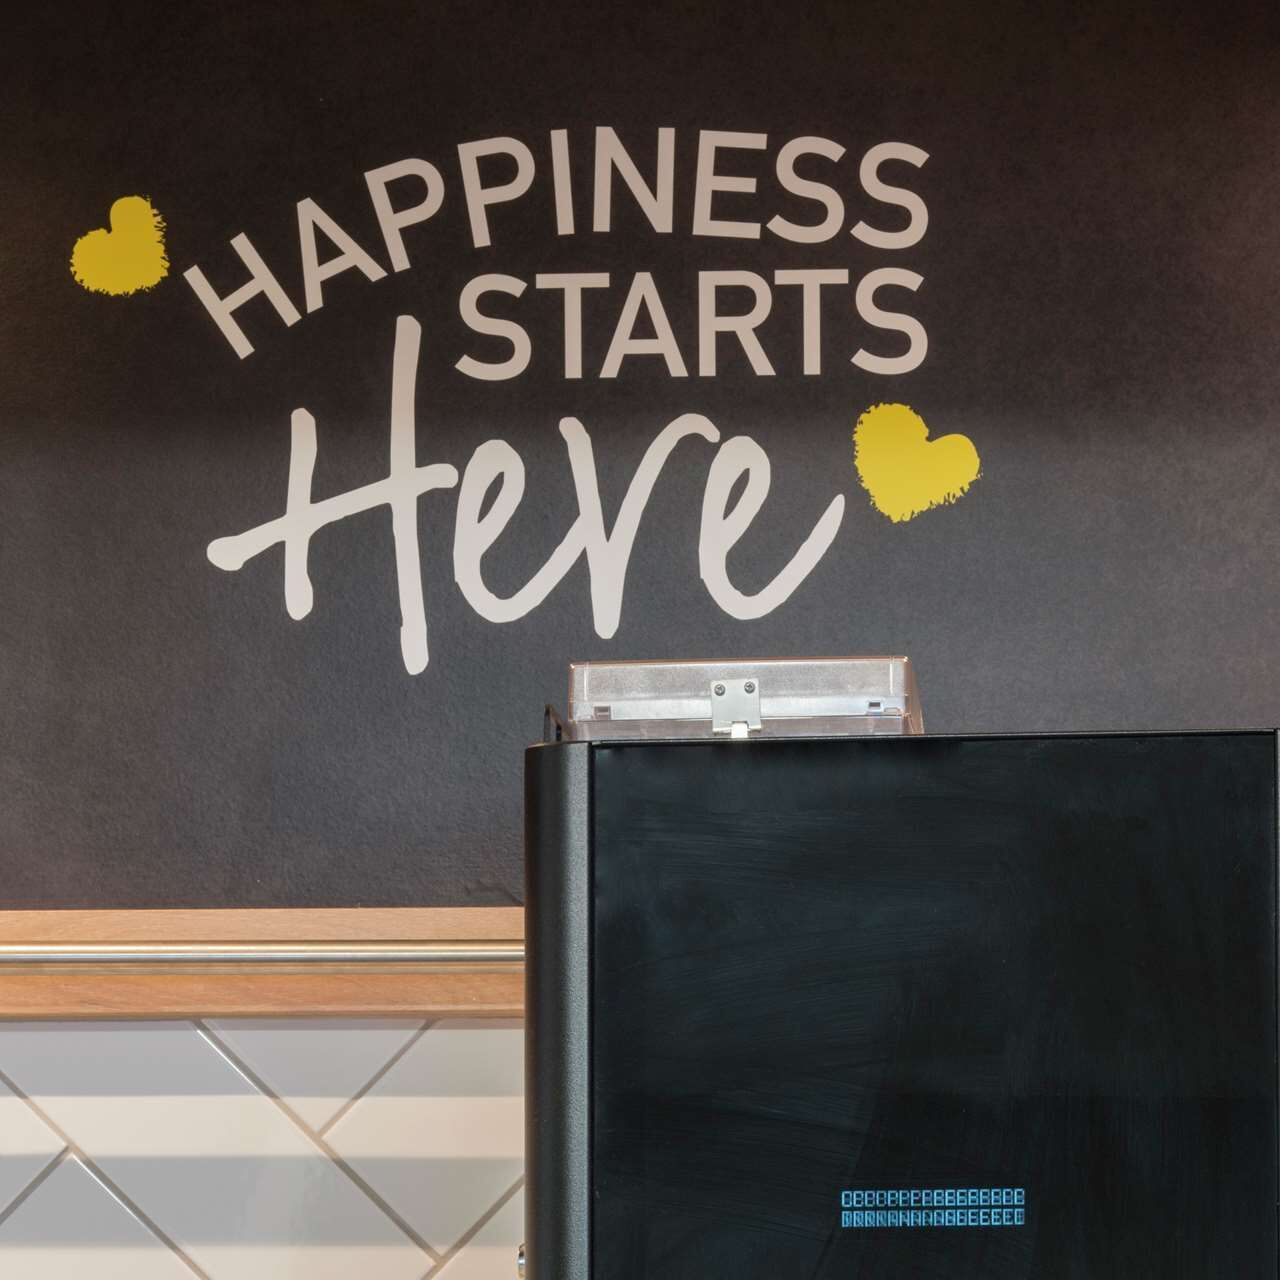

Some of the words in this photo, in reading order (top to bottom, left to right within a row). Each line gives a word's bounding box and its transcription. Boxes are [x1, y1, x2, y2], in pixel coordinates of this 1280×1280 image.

[182, 125, 930, 360] HAPPINESS
[454, 267, 929, 382] STARTS
[206, 314, 846, 676] Here
